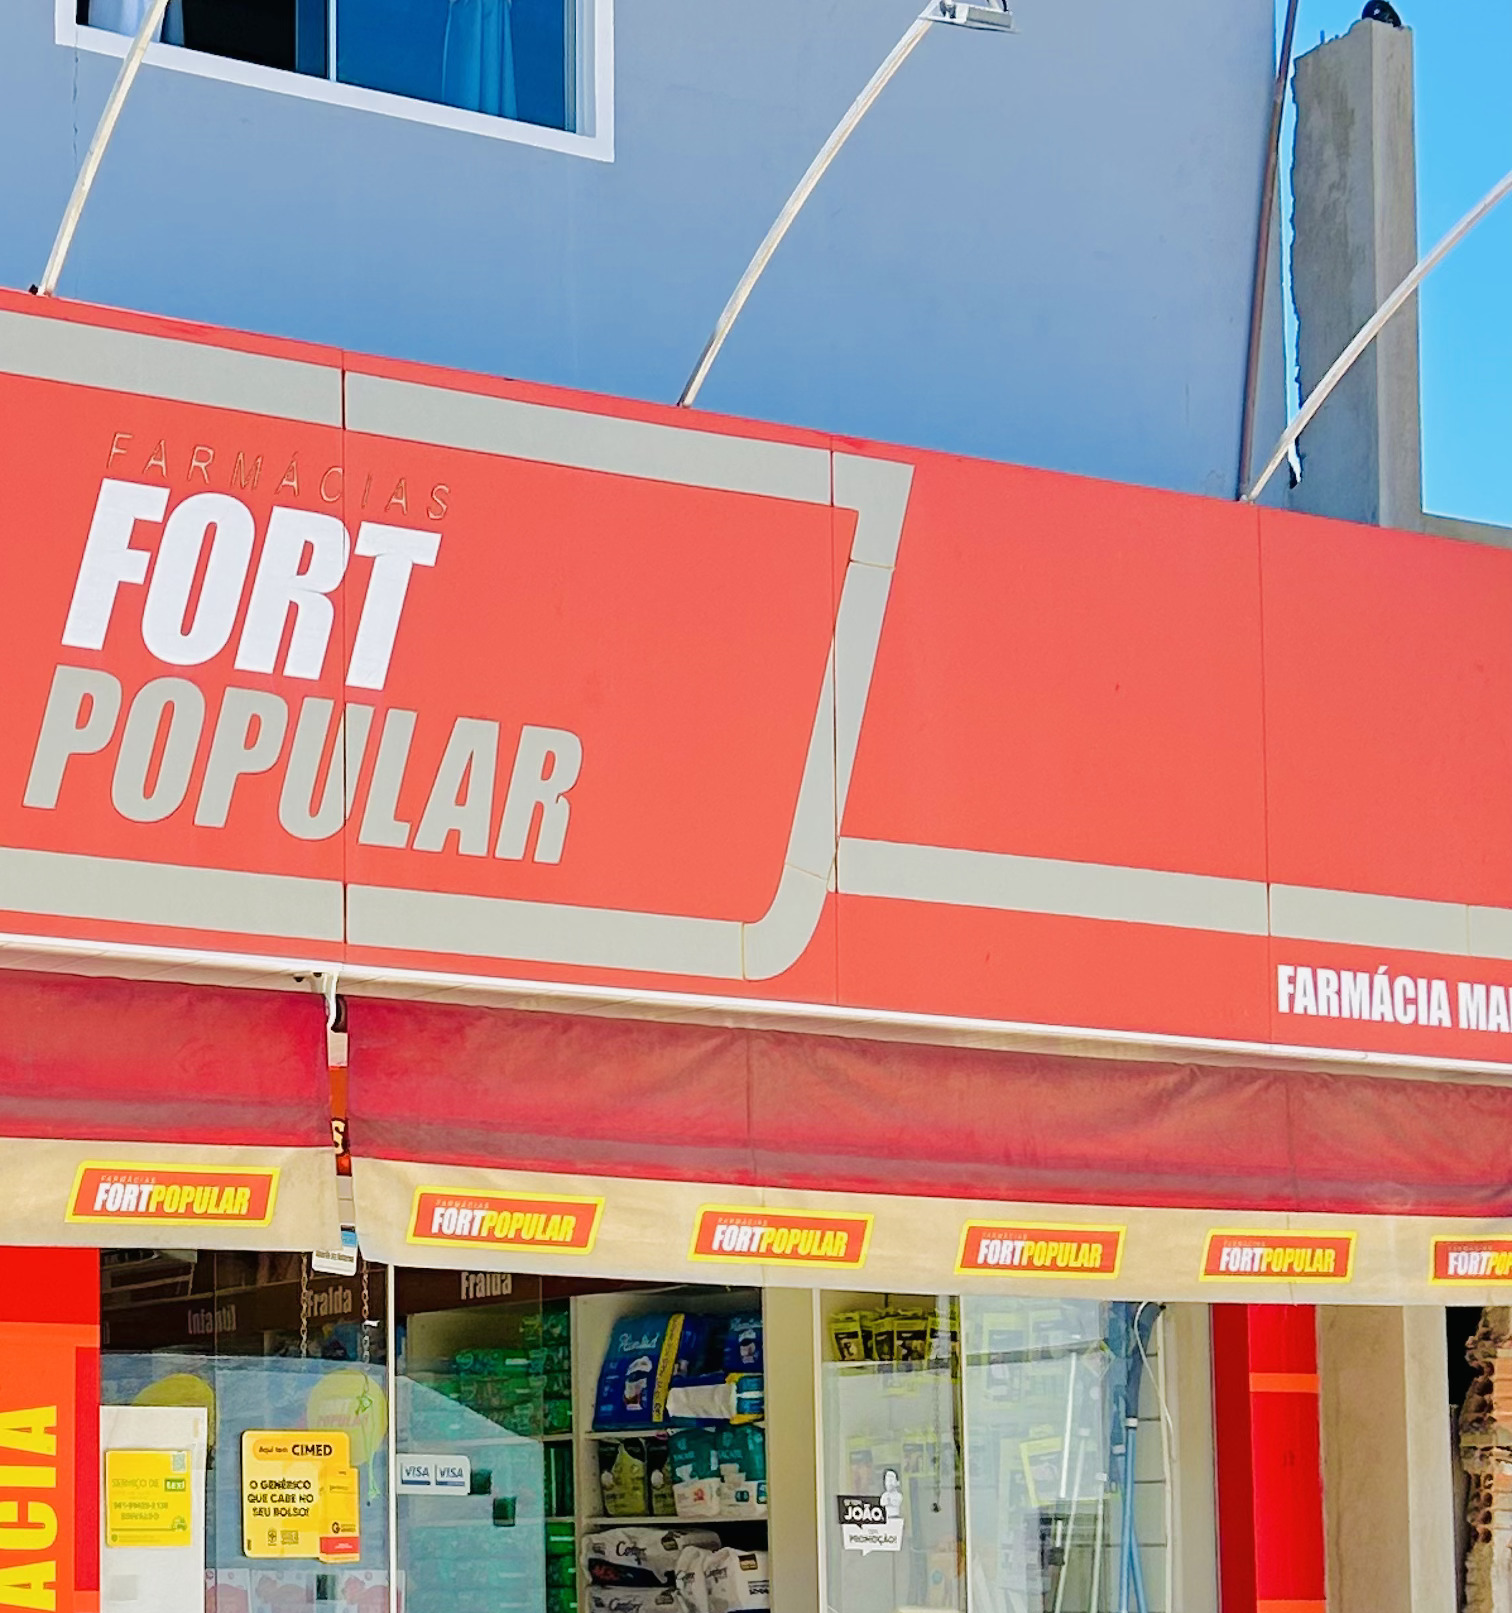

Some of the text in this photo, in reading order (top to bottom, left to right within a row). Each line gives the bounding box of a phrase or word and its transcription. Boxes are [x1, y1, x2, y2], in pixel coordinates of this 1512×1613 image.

[106, 432, 452, 520] FARMÁCIAS
[61, 477, 442, 691] FORT
[22, 664, 584, 866] POPULAR
[1277, 964, 1512, 1034] FARMÁCIA MA
[94, 1183, 250, 1216] FORTPOPULAR
[431, 1207, 576, 1242] FORTPOPULAR
[712, 1224, 848, 1258] FORTPOPULAR
[977, 1239, 1104, 1269] FORTPOPULAR
[1219, 1247, 1336, 1274] FORTPOPULAR
[291, 1443, 333, 1457] CIMED
[249, 1477, 312, 1490] O GENÉRICO
[405, 1465, 463, 1478] VISA VISA
[247, 1493, 314, 1504] QUE CABE NO
[253, 1507, 310, 1517] SEU BOLSO!
[843, 1503, 883, 1521] JOÃO
[331, 1521, 340, 1534] G
